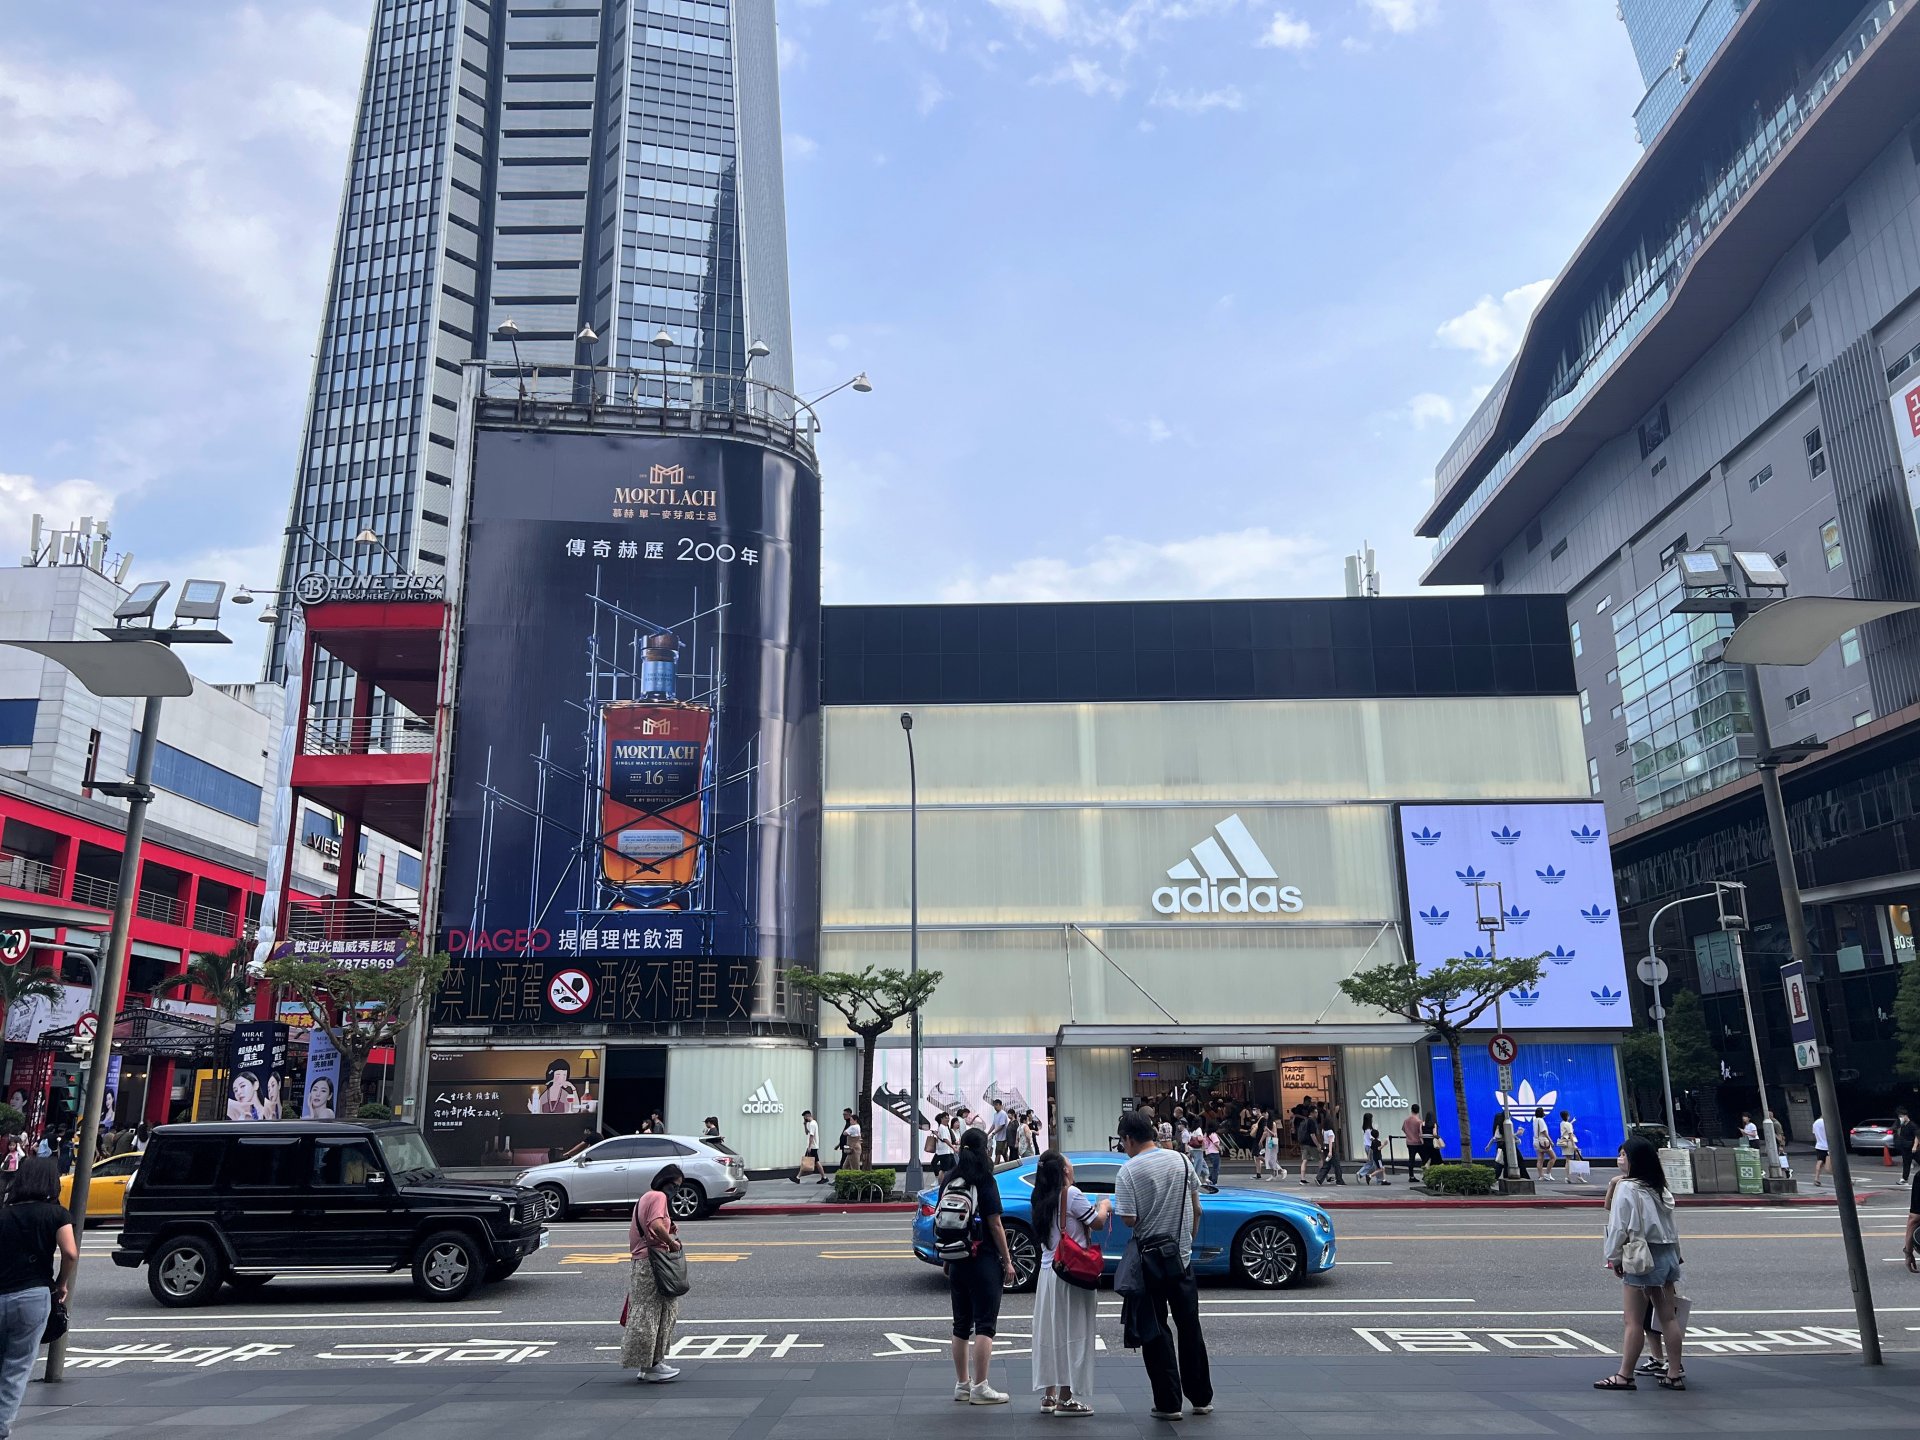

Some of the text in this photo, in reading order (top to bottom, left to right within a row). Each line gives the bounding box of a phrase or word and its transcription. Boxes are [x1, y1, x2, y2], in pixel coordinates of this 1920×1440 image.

[613, 487, 717, 507] MORTLACH
[612, 508, 718, 522] 慕赫 單一麥芽威士忌
[676, 537, 759, 566] 200年
[337, 574, 388, 589] ONE
[392, 574, 445, 589] BOY
[614, 745, 695, 760] MORTLACH
[644, 769, 664, 785] 16
[1151, 877, 1304, 914] adidas
[294, 940, 396, 954] 歡迎光臨威秀影城
[449, 929, 551, 952] DIAGEO
[558, 928, 684, 951] 提倡理性飲酒
[440, 959, 544, 1021] 禁止酒駕
[593, 957, 719, 1020] 酒後不開車
[742, 1101, 785, 1114] adidas
[1360, 1095, 1409, 1109] adidas
